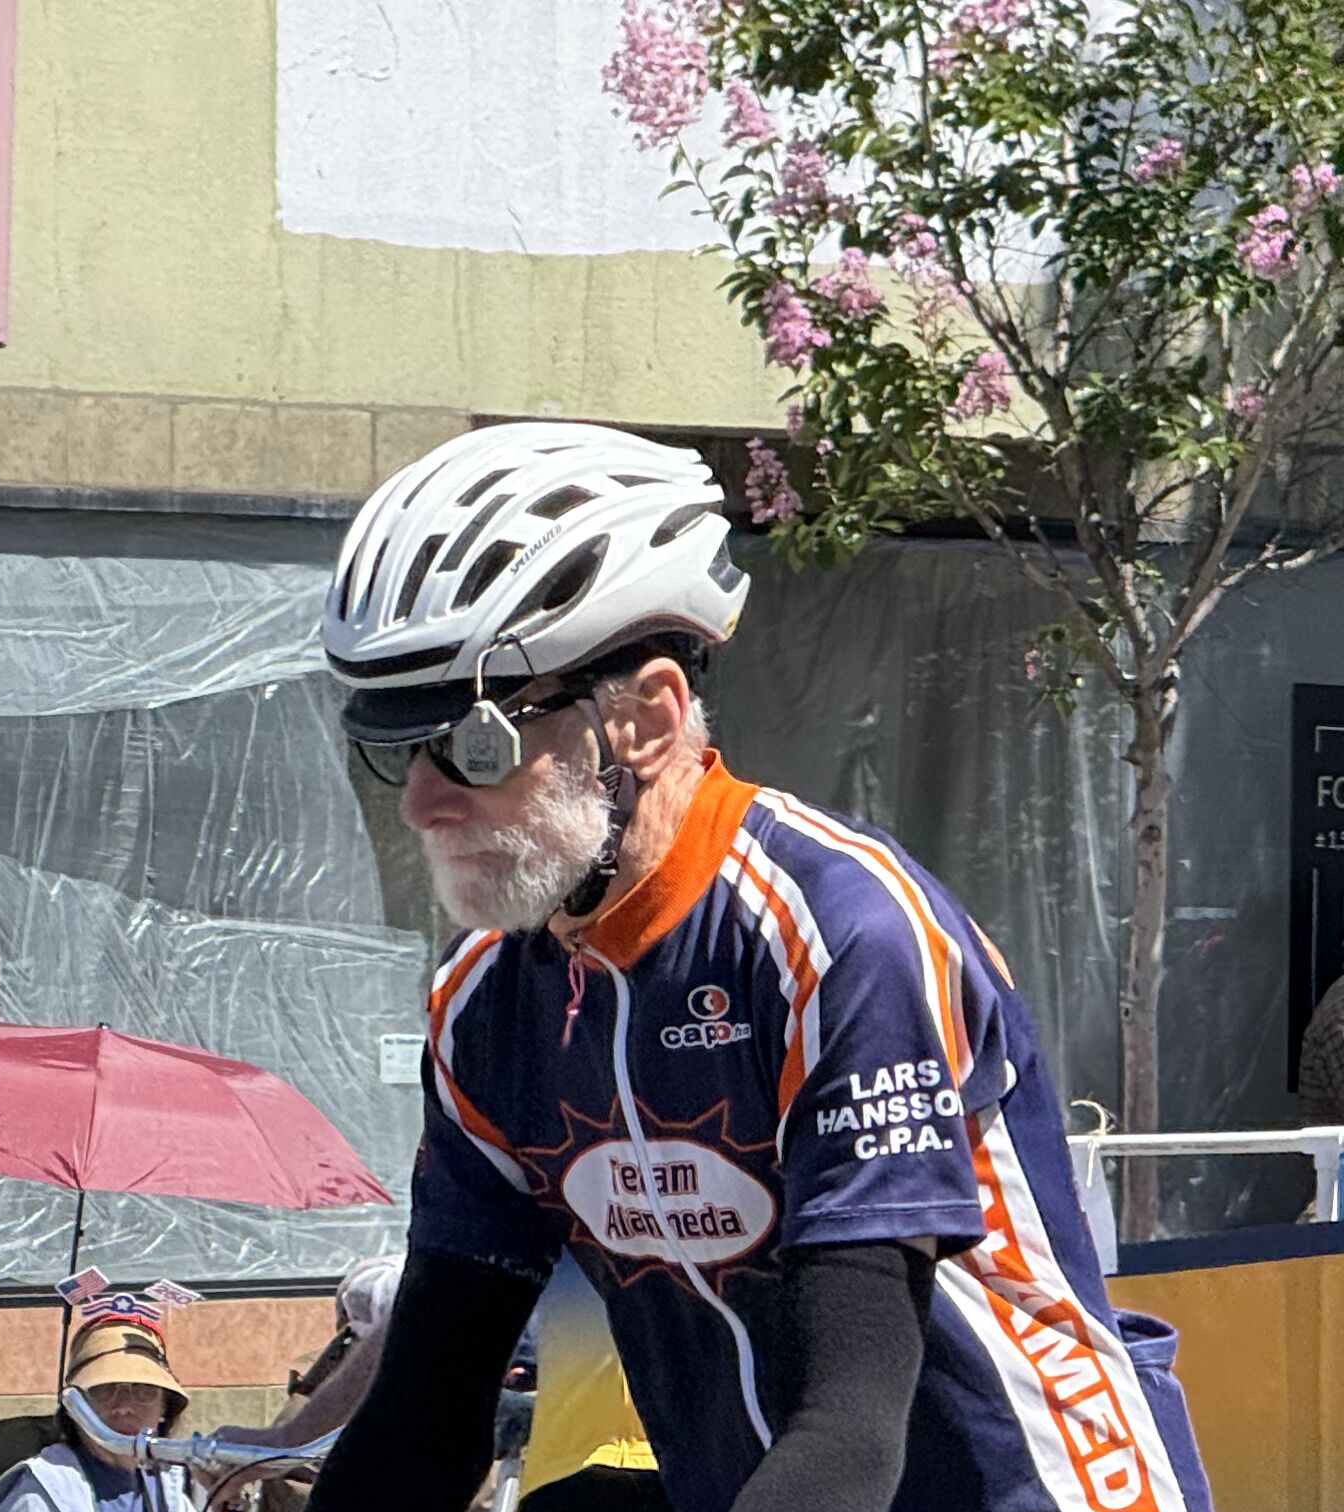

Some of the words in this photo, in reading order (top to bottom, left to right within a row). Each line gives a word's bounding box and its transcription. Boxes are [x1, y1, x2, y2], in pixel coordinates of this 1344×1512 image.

[660, 1022, 732, 1049] capo
[849, 1059, 941, 1100] LARS
[855, 1125, 953, 1160] C.P.A.
